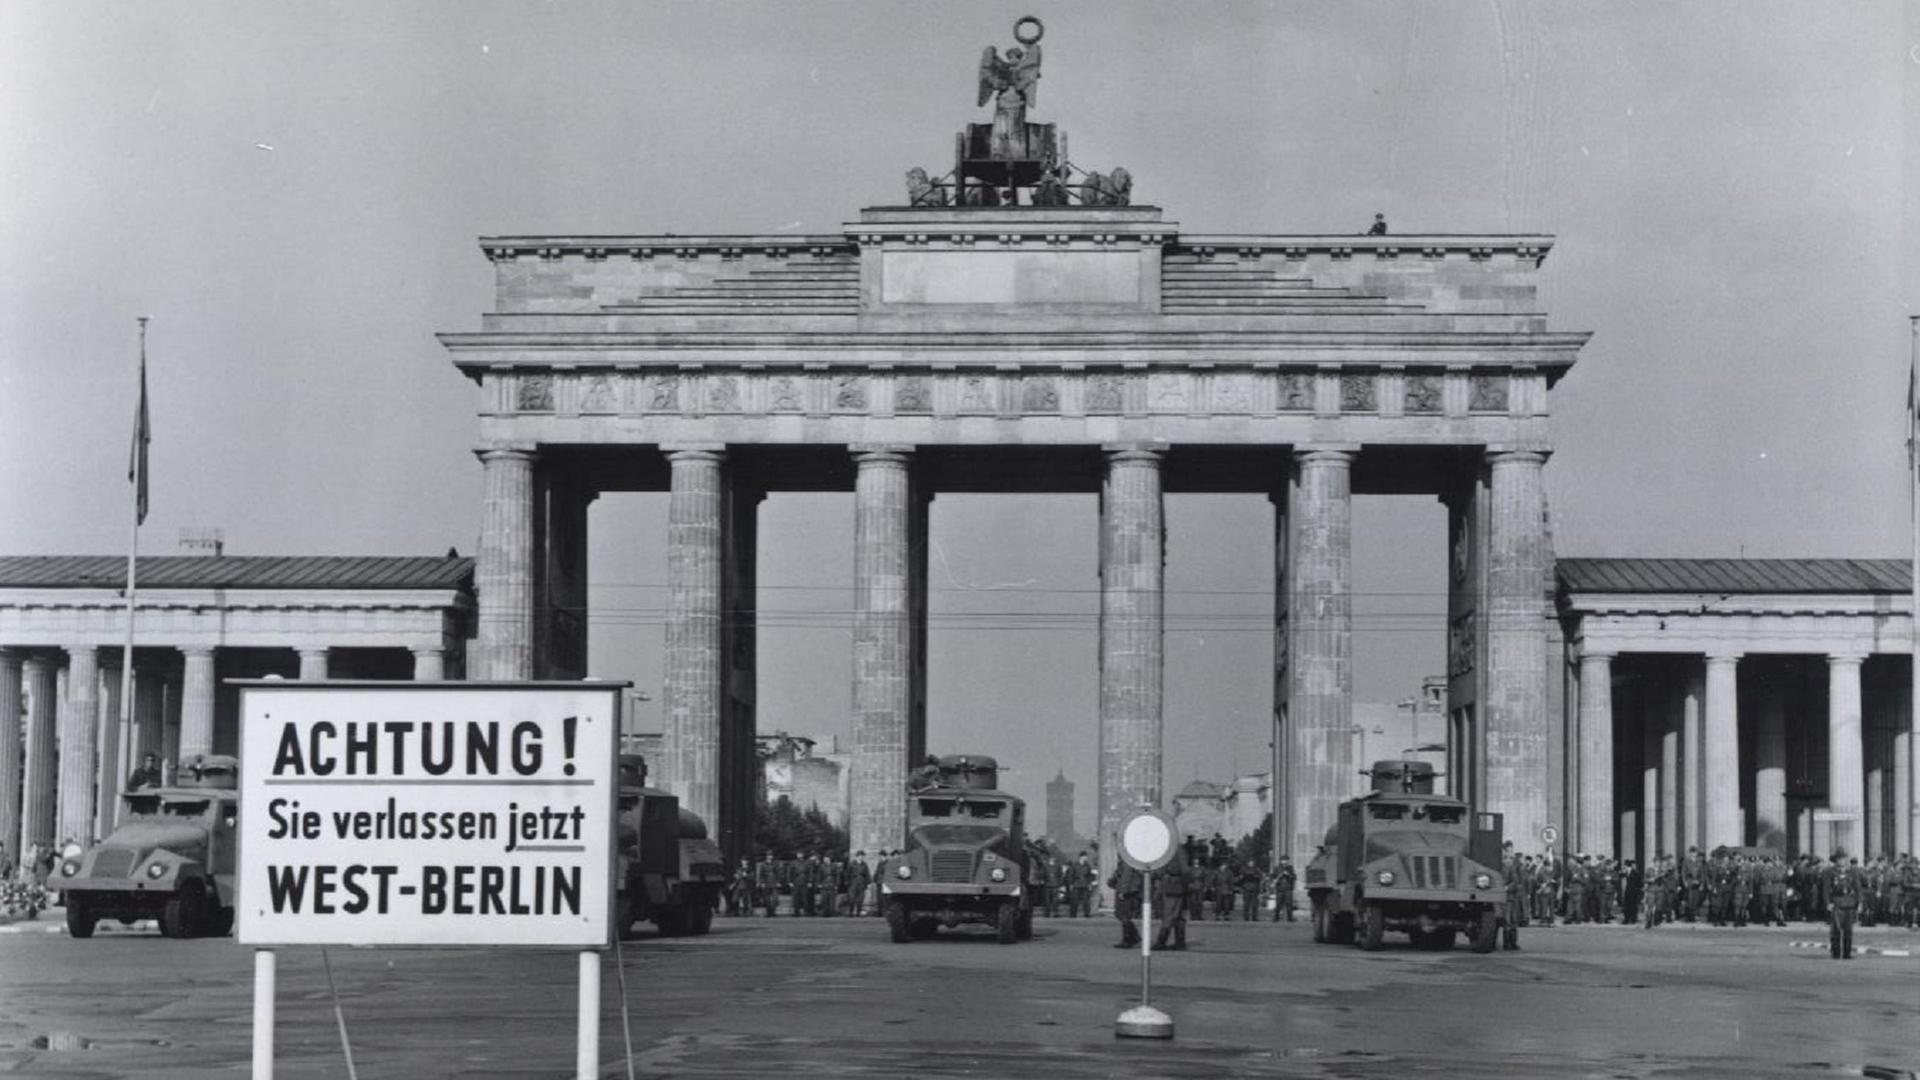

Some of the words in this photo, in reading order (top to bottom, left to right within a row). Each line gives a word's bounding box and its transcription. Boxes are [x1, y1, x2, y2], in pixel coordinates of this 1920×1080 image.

[268, 798, 321, 841] Sie
[332, 797, 497, 841] verlassen
[504, 803, 585, 853] jetzt
[268, 864, 582, 916] WEST-BERLIN
